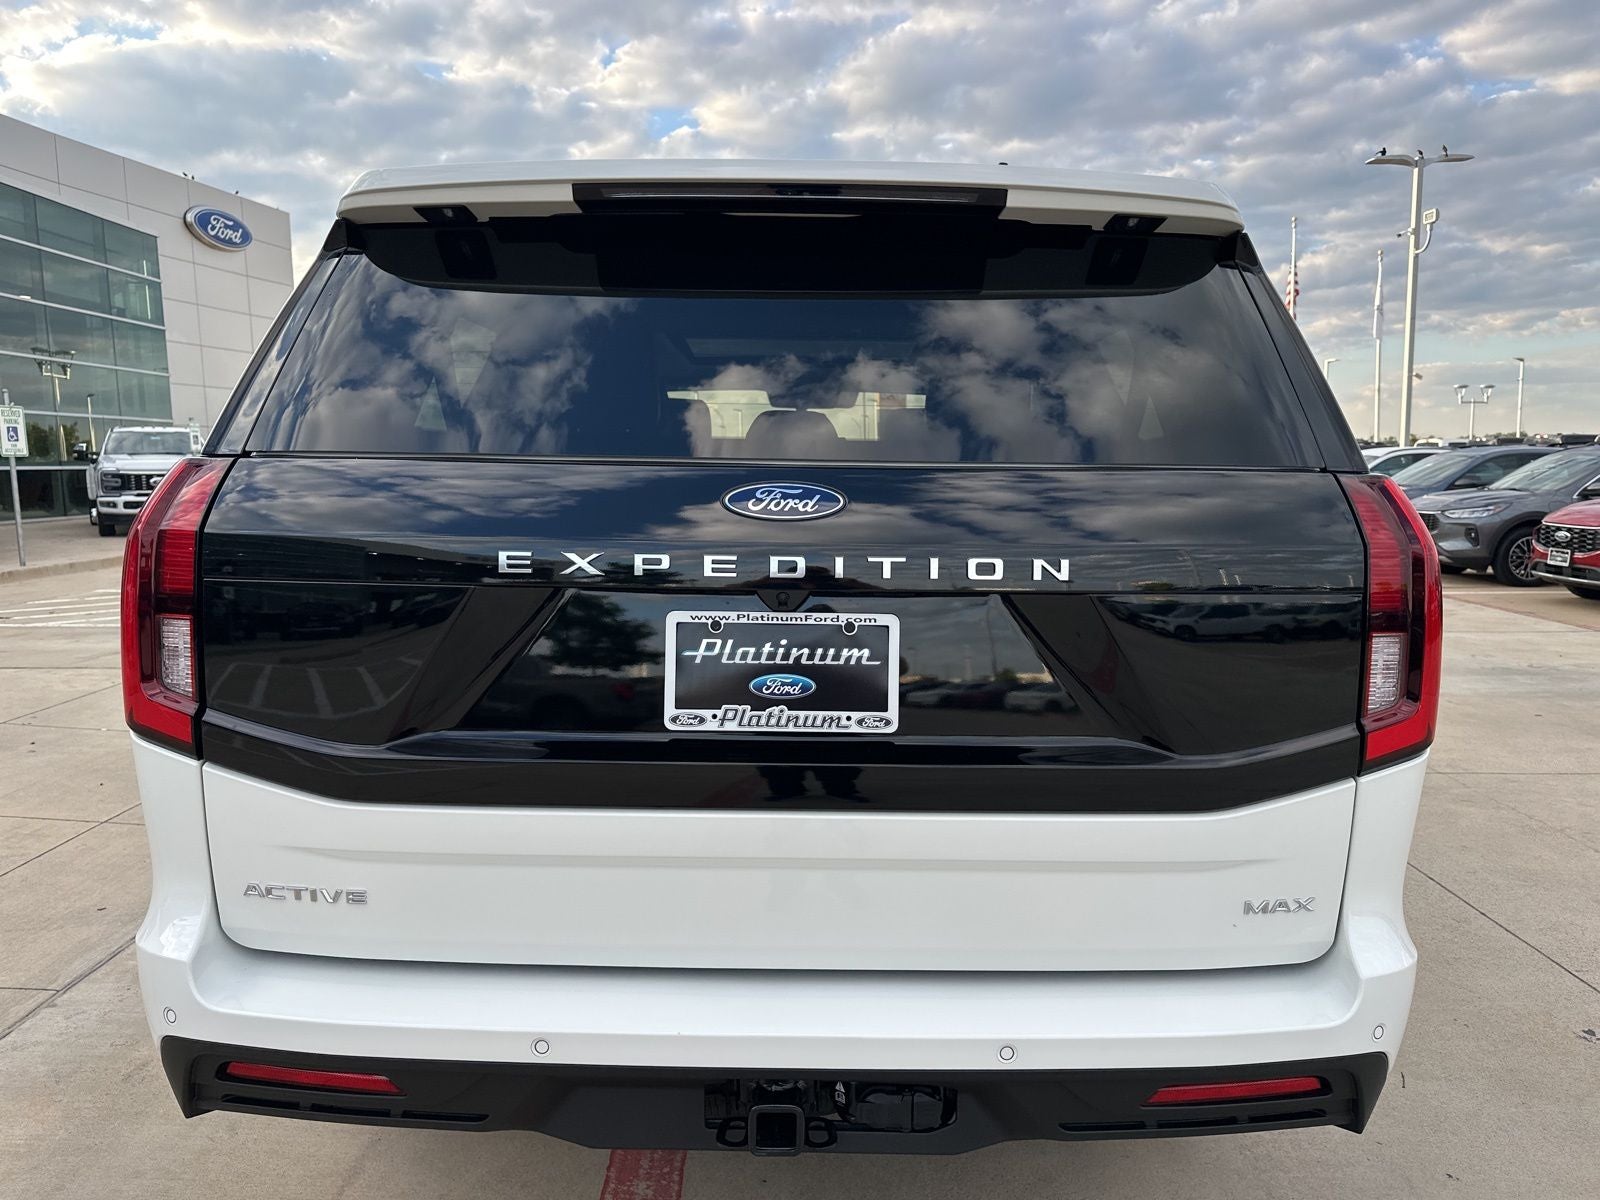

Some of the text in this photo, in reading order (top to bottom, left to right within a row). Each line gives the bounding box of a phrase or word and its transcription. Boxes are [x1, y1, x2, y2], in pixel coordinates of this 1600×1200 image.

[208, 215, 242, 243] Ford
[748, 487, 821, 512] Ford
[497, 550, 1071, 582] EXPEDITION
[690, 613, 878, 625] www.PlatinumFord.com
[681, 638, 882, 665] Platinum
[762, 676, 802, 695] Ford
[675, 713, 701, 725] Ford
[716, 706, 852, 730] Platinum
[862, 716, 886, 728] Ford
[243, 882, 368, 905] ACTIVE
[1243, 896, 1316, 915] MAX
